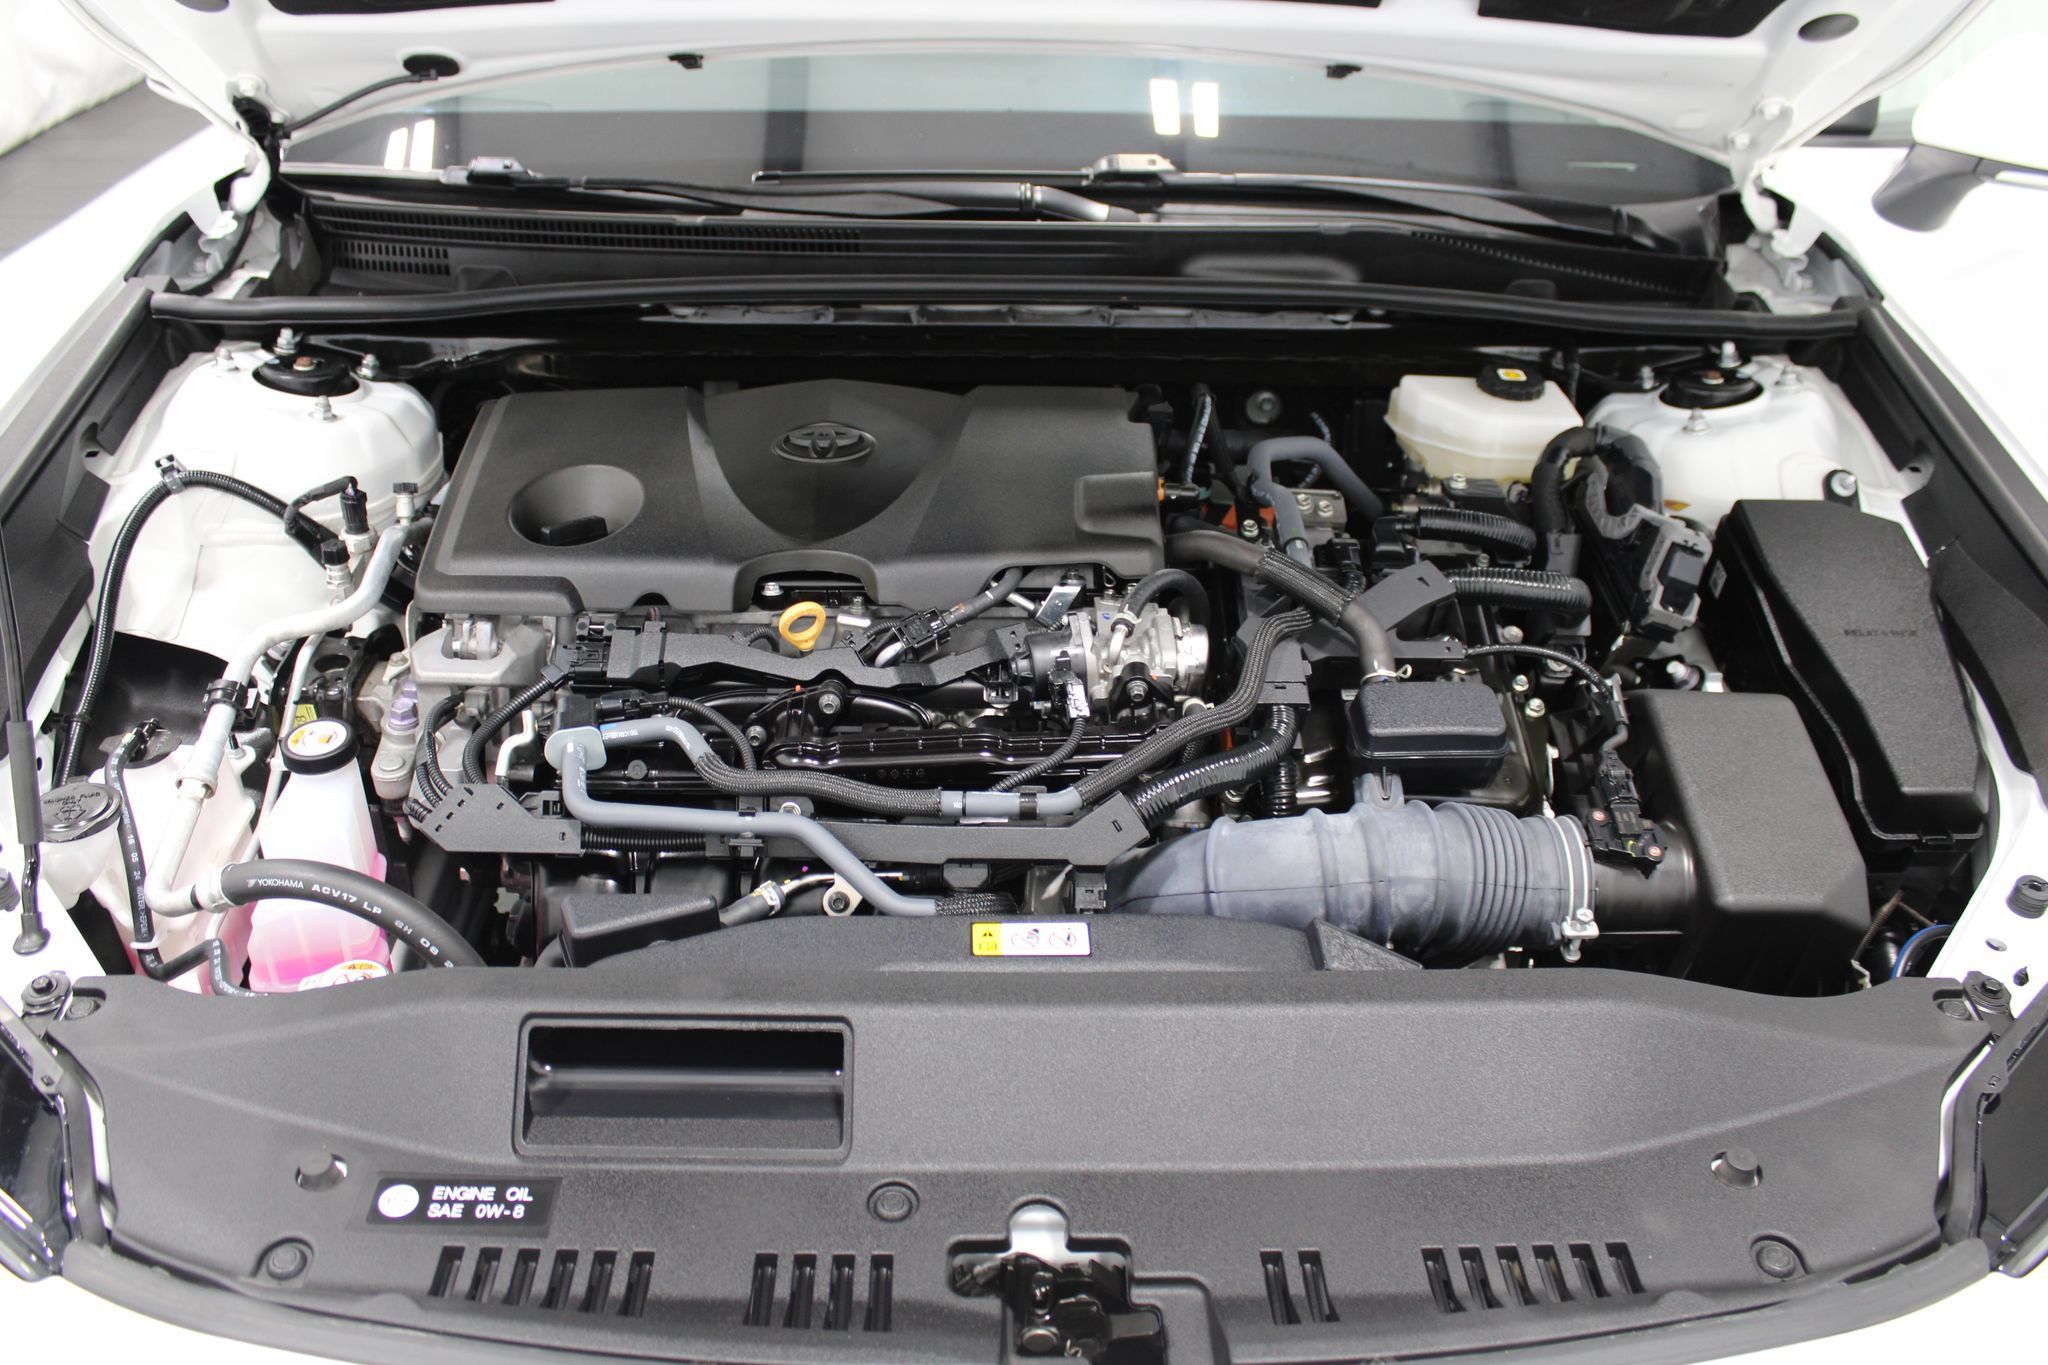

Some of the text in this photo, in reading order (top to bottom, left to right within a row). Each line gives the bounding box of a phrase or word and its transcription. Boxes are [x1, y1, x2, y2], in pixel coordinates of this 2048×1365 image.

[257, 879, 304, 889] YOKOHAMA
[311, 884, 358, 903] ACV17
[362, 901, 382, 914] LP
[432, 1186, 533, 1202] ENGINE OIL
[427, 1202, 525, 1219] SAE 0W-8
